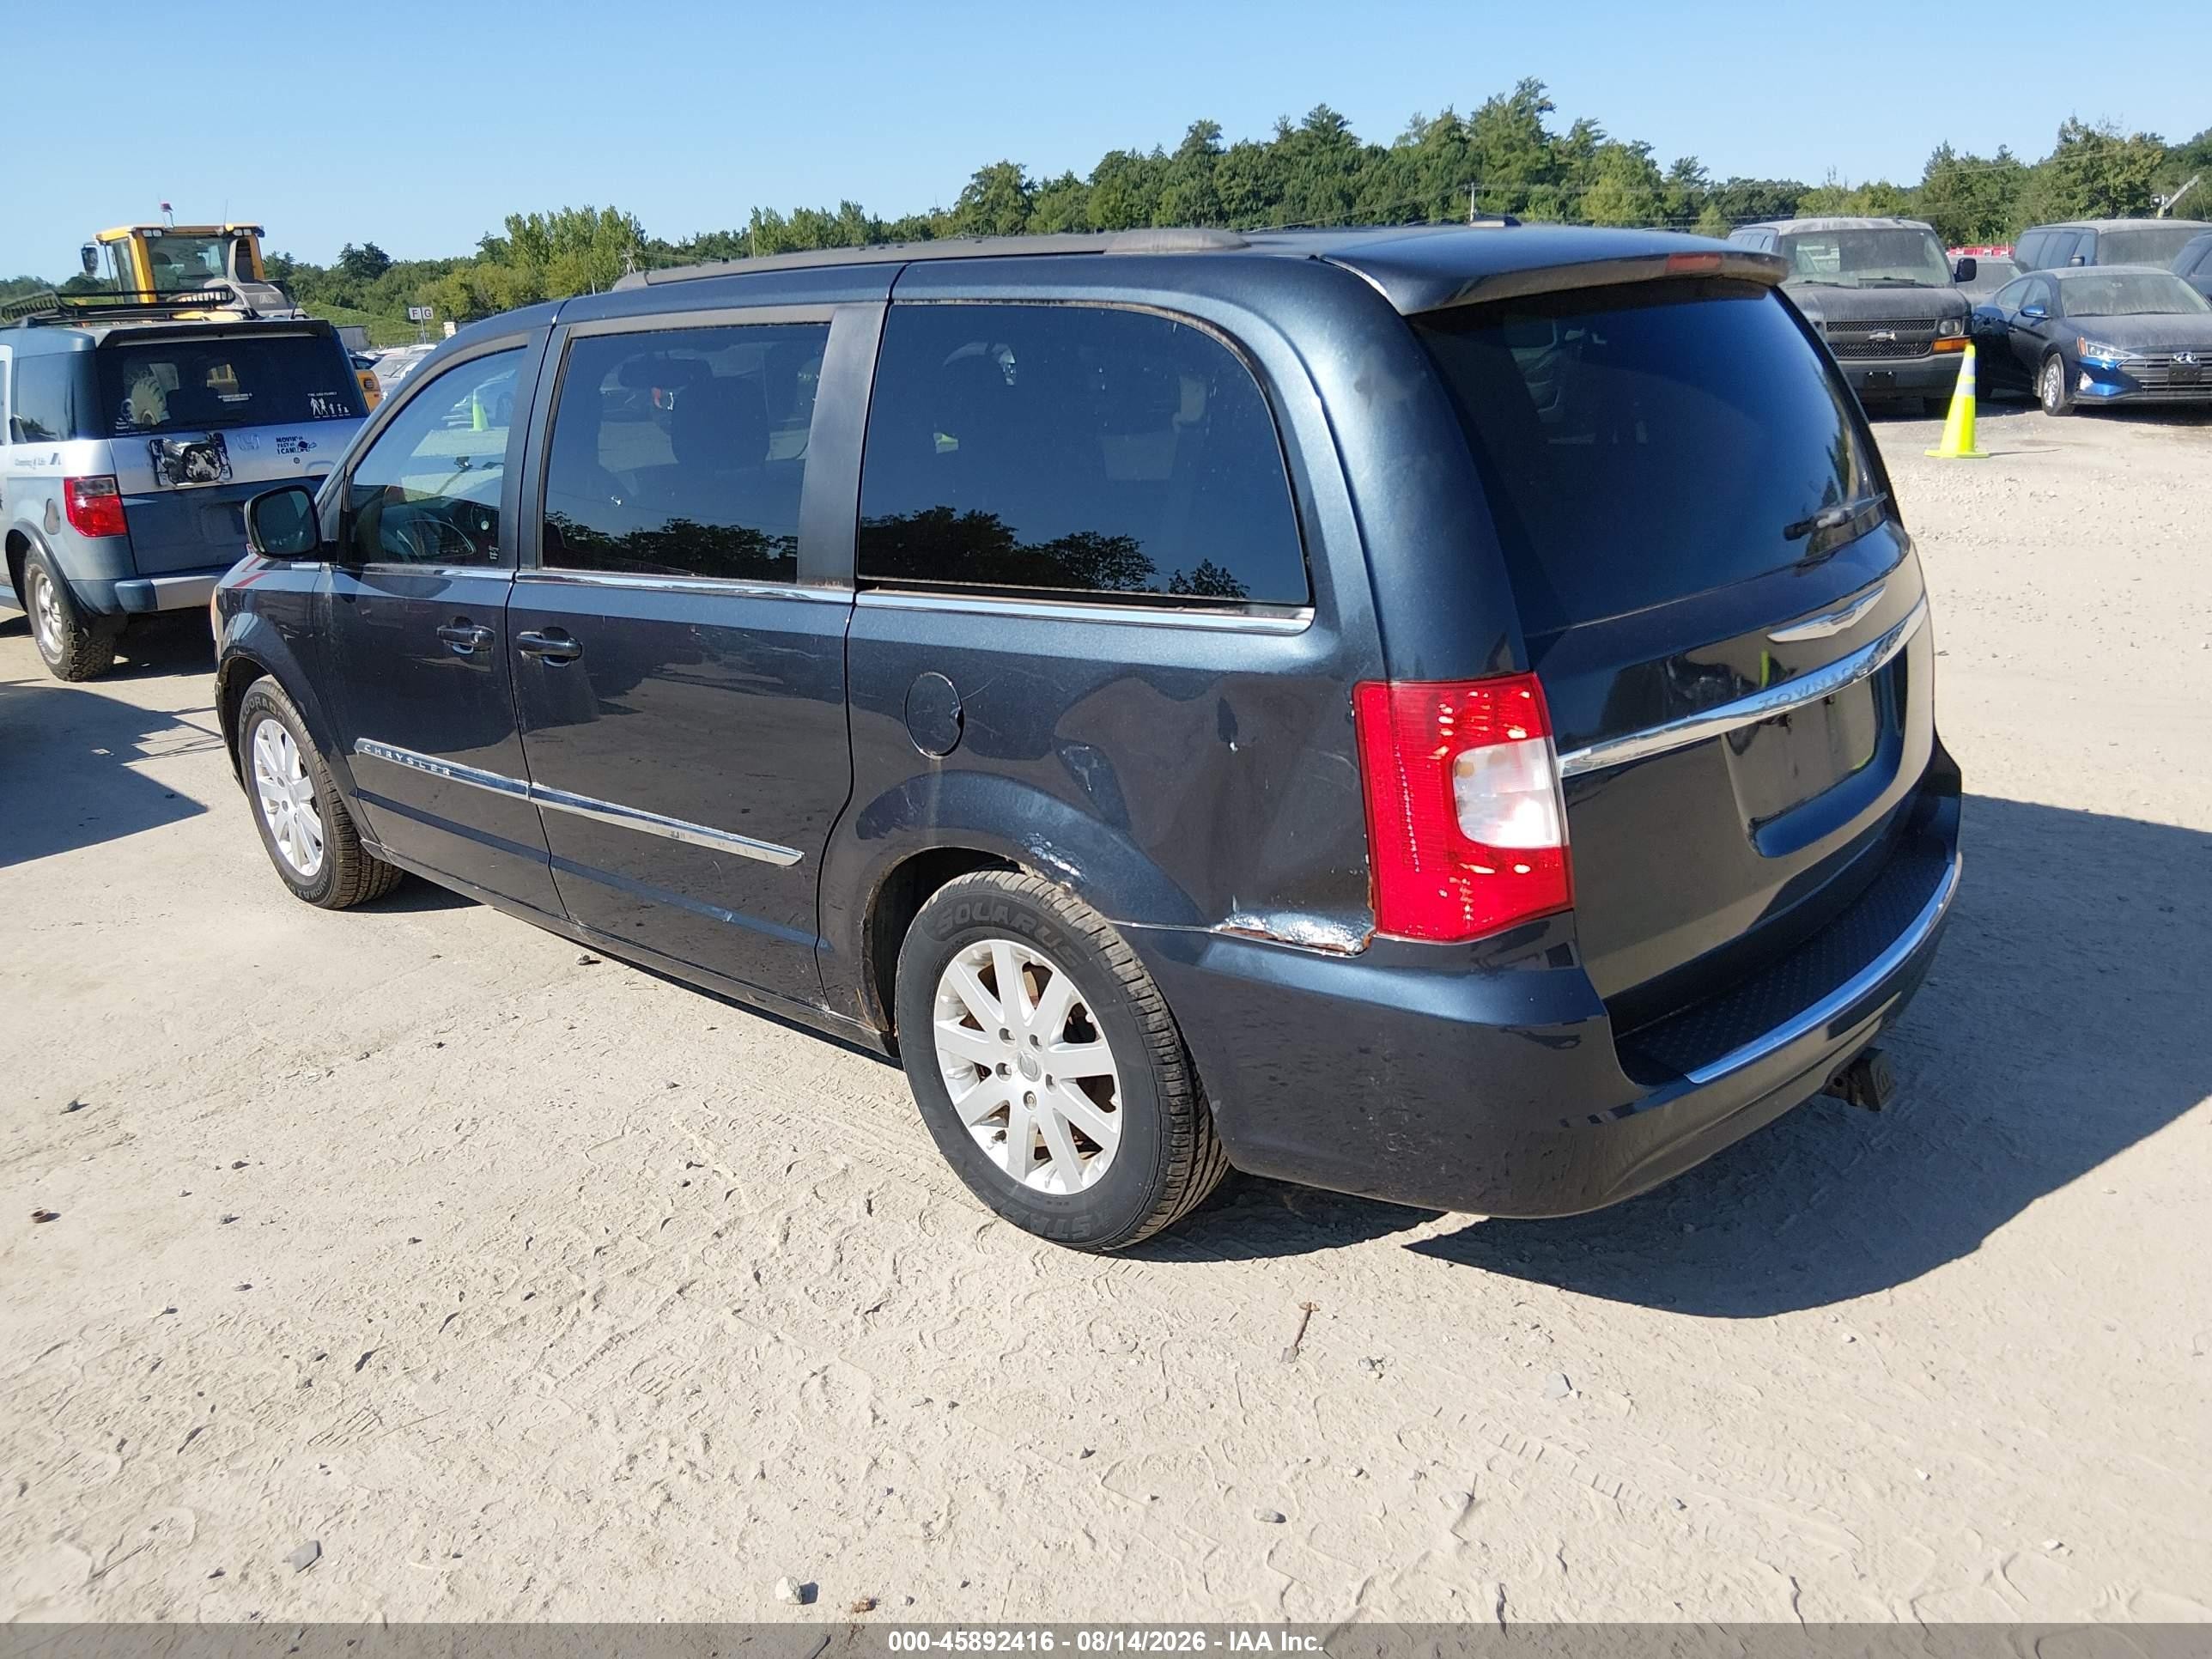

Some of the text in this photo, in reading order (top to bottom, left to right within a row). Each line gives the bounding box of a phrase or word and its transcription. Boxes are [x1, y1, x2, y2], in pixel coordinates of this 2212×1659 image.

[412, 309, 418, 318] F
[424, 309, 432, 318] G
[364, 744, 450, 775] CHRYSLER
[936, 902, 1087, 969] SOLARUS
